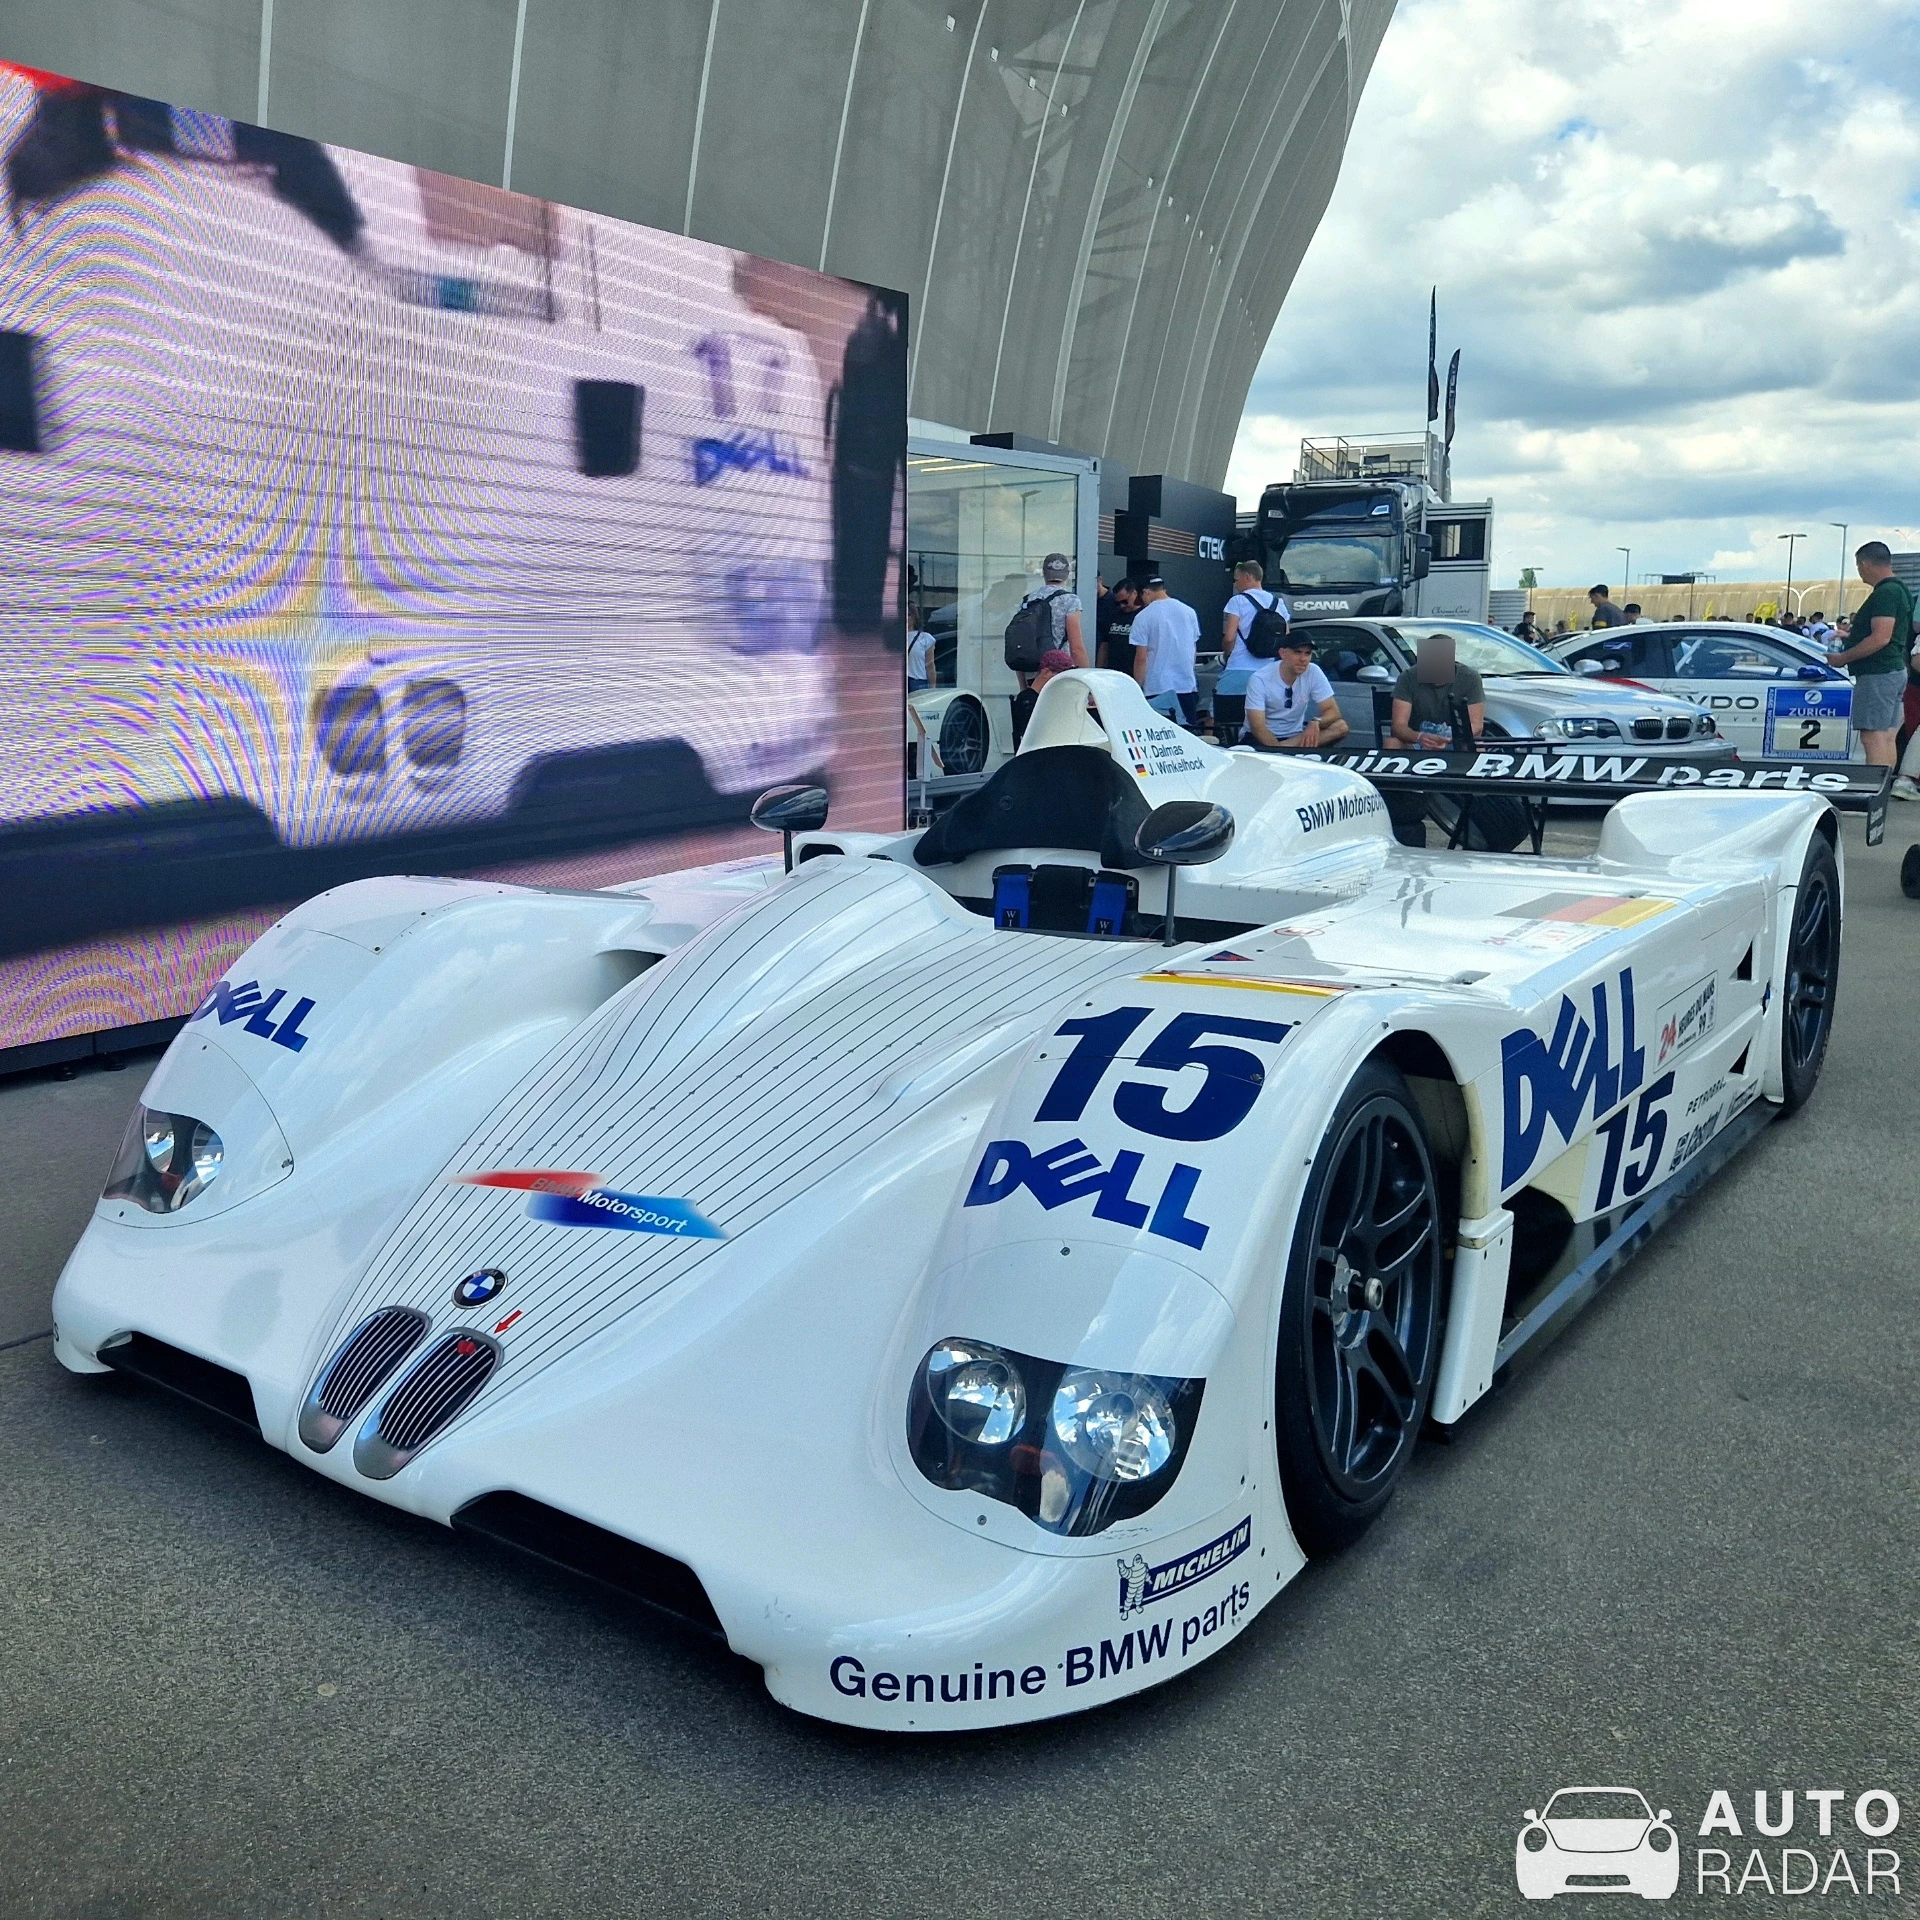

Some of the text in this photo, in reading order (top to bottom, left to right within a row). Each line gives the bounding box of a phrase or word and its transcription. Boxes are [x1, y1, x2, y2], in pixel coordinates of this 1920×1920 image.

[1199, 535, 1226, 561] CTEK
[1292, 600, 1350, 611] SCANIA
[1134, 727, 1176, 743] P. Martini
[1788, 707, 1837, 717] ZURICH
[1799, 719, 1822, 750] 2
[1140, 743, 1184, 760] Y. Dalmas
[1148, 757, 1205, 776] J. Winkelhock
[1466, 752, 1648, 782] BMW
[1656, 765, 1850, 792] parts
[1295, 799, 1334, 833] BMW
[189, 980, 316, 1053] DELL
[1658, 1012, 1677, 1066] 24
[1033, 1006, 1293, 1142] 15
[1501, 966, 1646, 1193] DELL
[1594, 1070, 1676, 1212] 15
[529, 1177, 689, 1233] BMW Motorsport
[963, 1137, 1210, 1251] DELL
[1152, 1523, 1249, 1592] MICHELIN
[829, 1580, 1250, 1703] Genuine BMW parts
